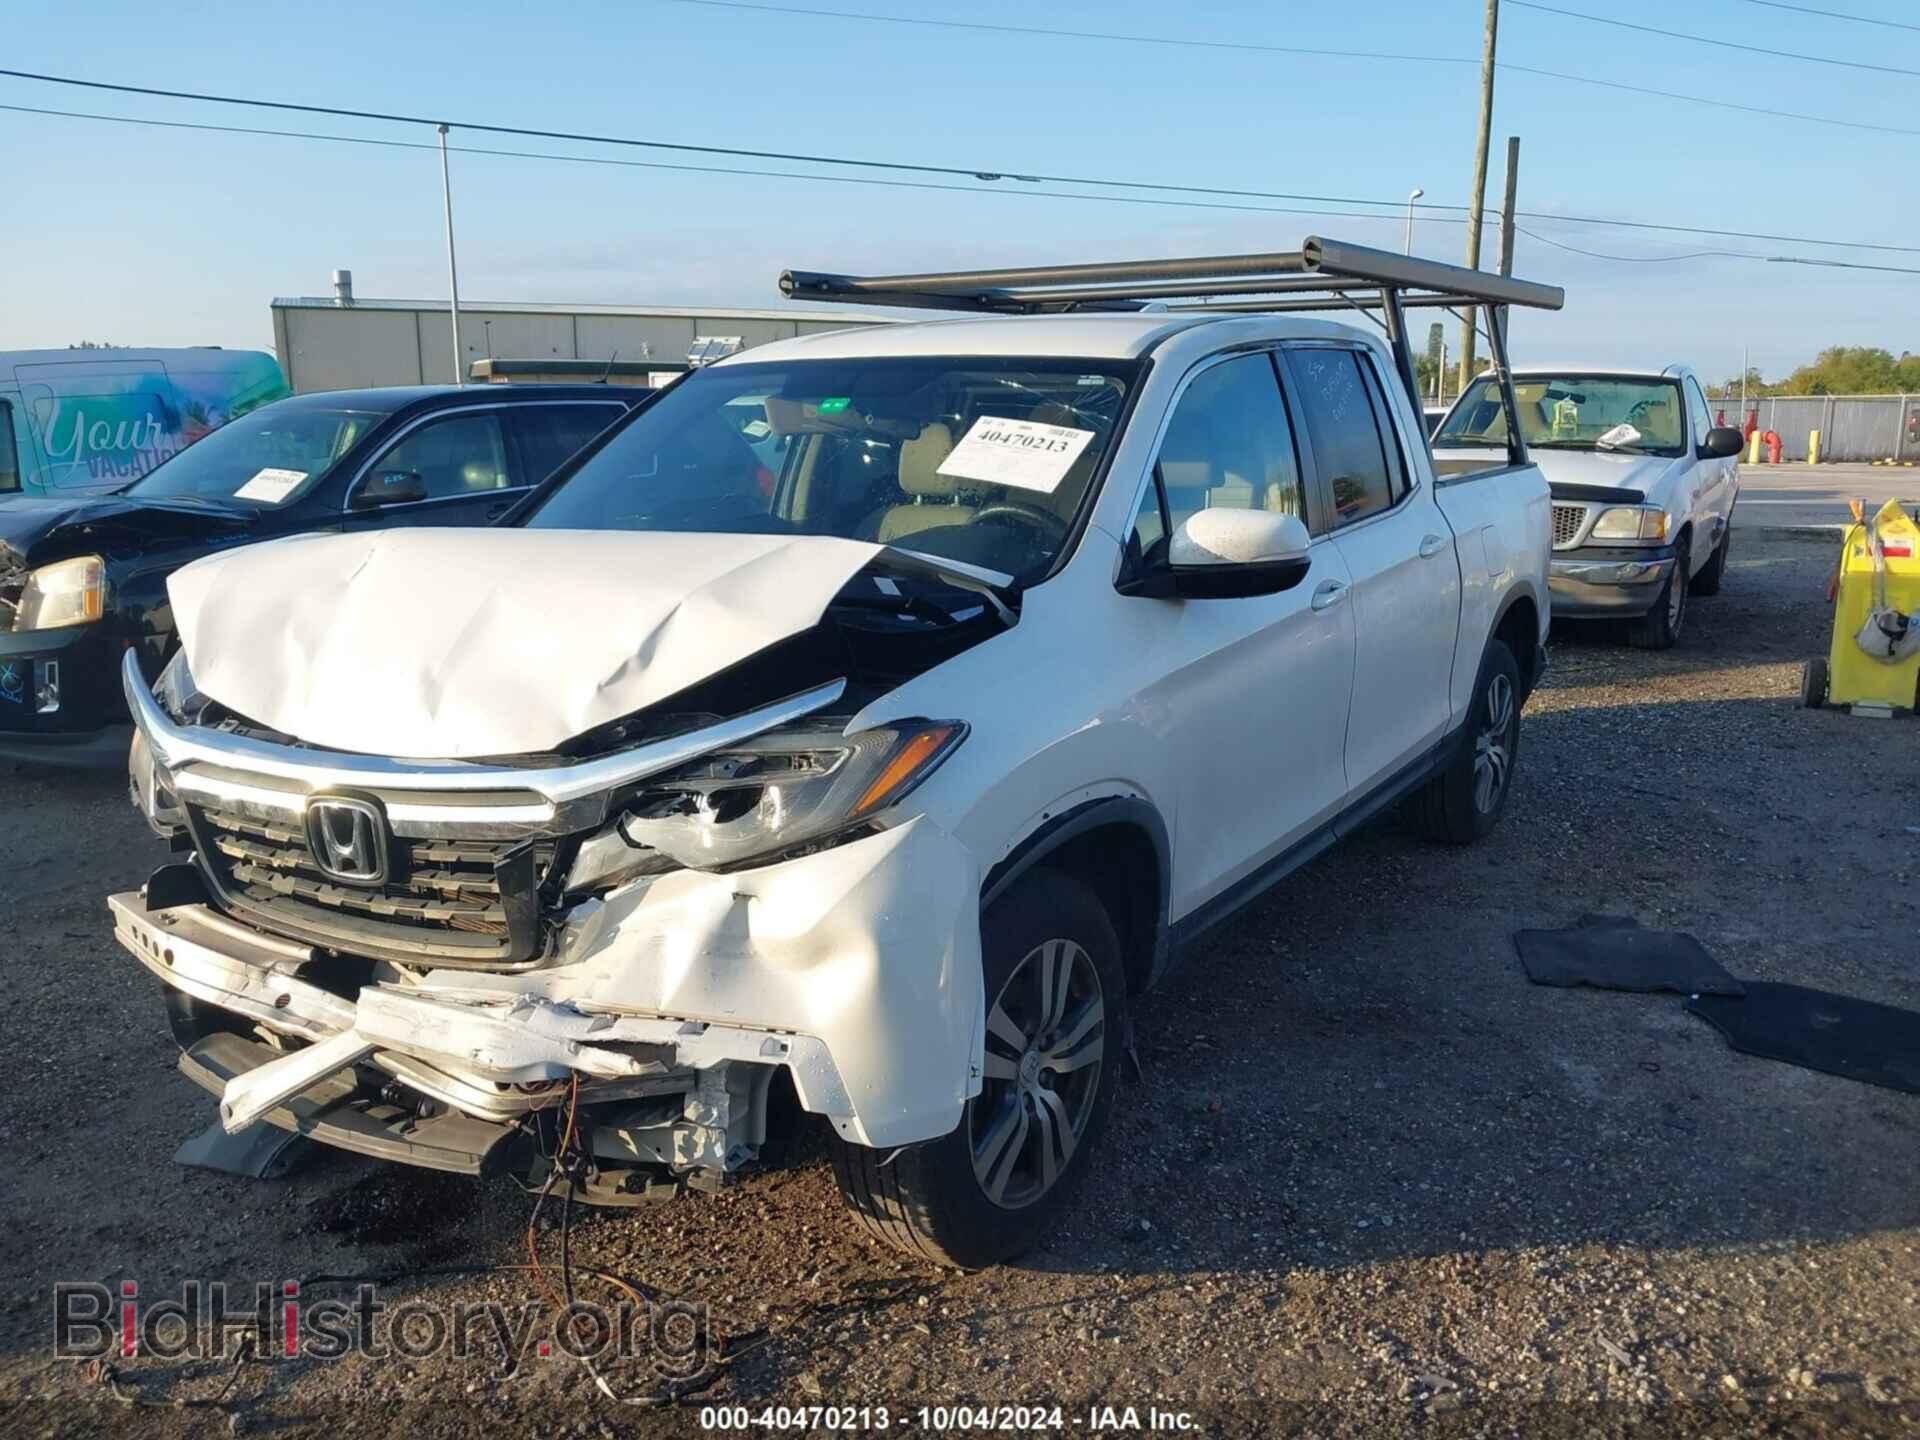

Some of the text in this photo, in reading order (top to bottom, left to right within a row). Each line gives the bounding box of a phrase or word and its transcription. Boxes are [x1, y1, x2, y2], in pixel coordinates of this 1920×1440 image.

[28, 384, 162, 486] Your
[978, 430, 1068, 453] 40470213
[87, 448, 177, 478] VACATI
